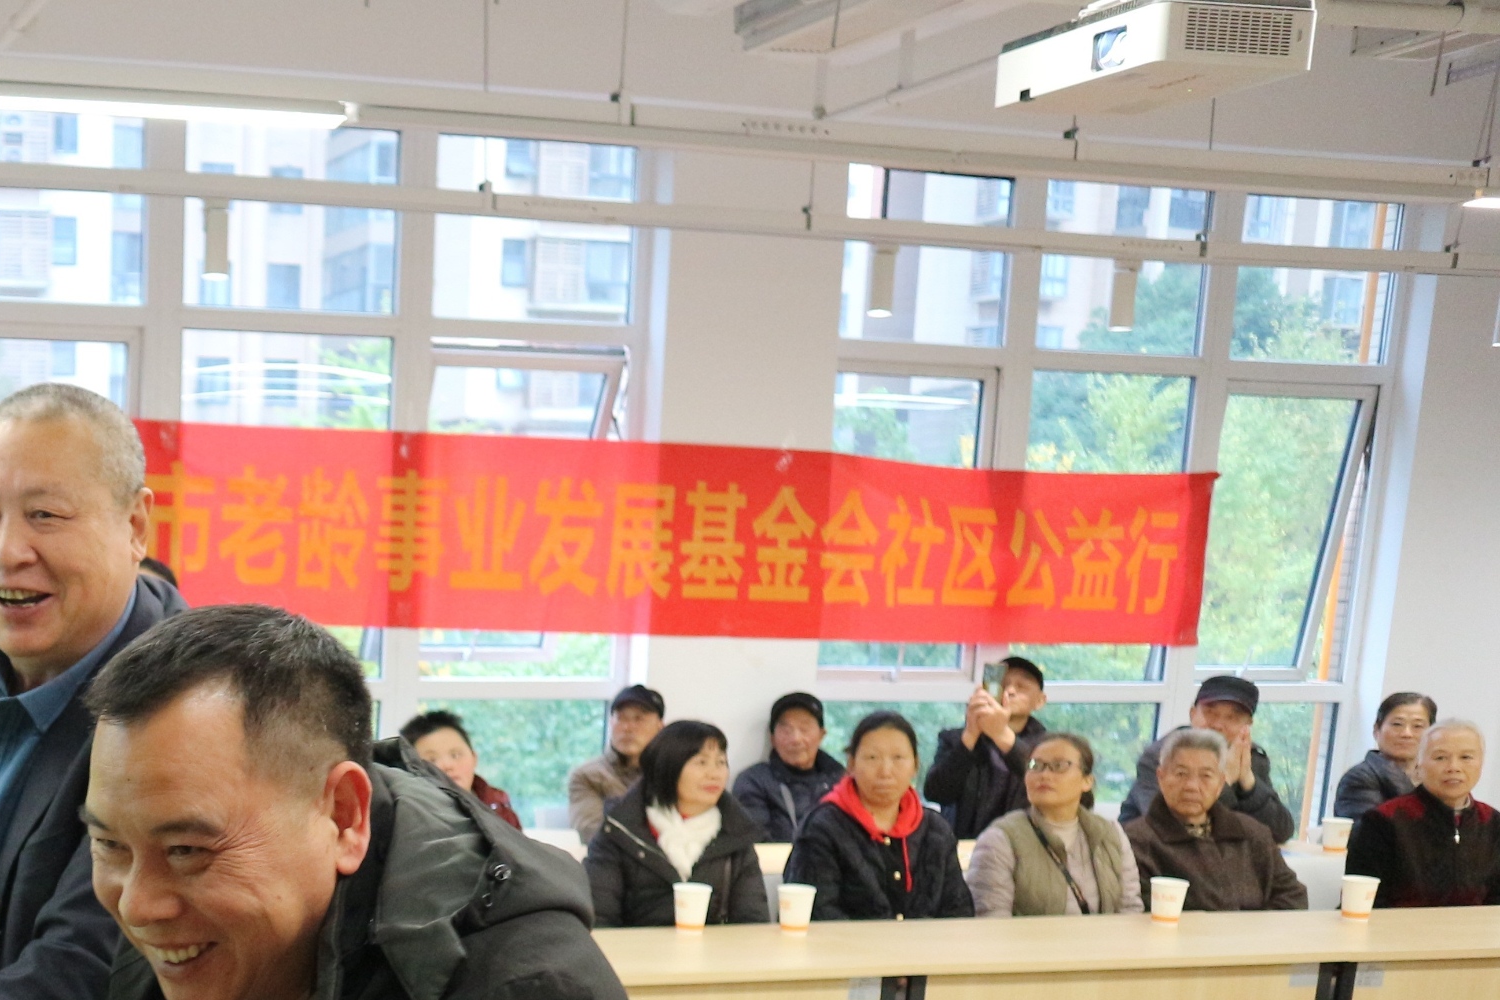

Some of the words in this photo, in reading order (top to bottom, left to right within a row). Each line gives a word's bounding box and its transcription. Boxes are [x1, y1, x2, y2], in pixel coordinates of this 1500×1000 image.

[145, 460, 1180, 614] 市老龄事业发展基金会社区公益行
